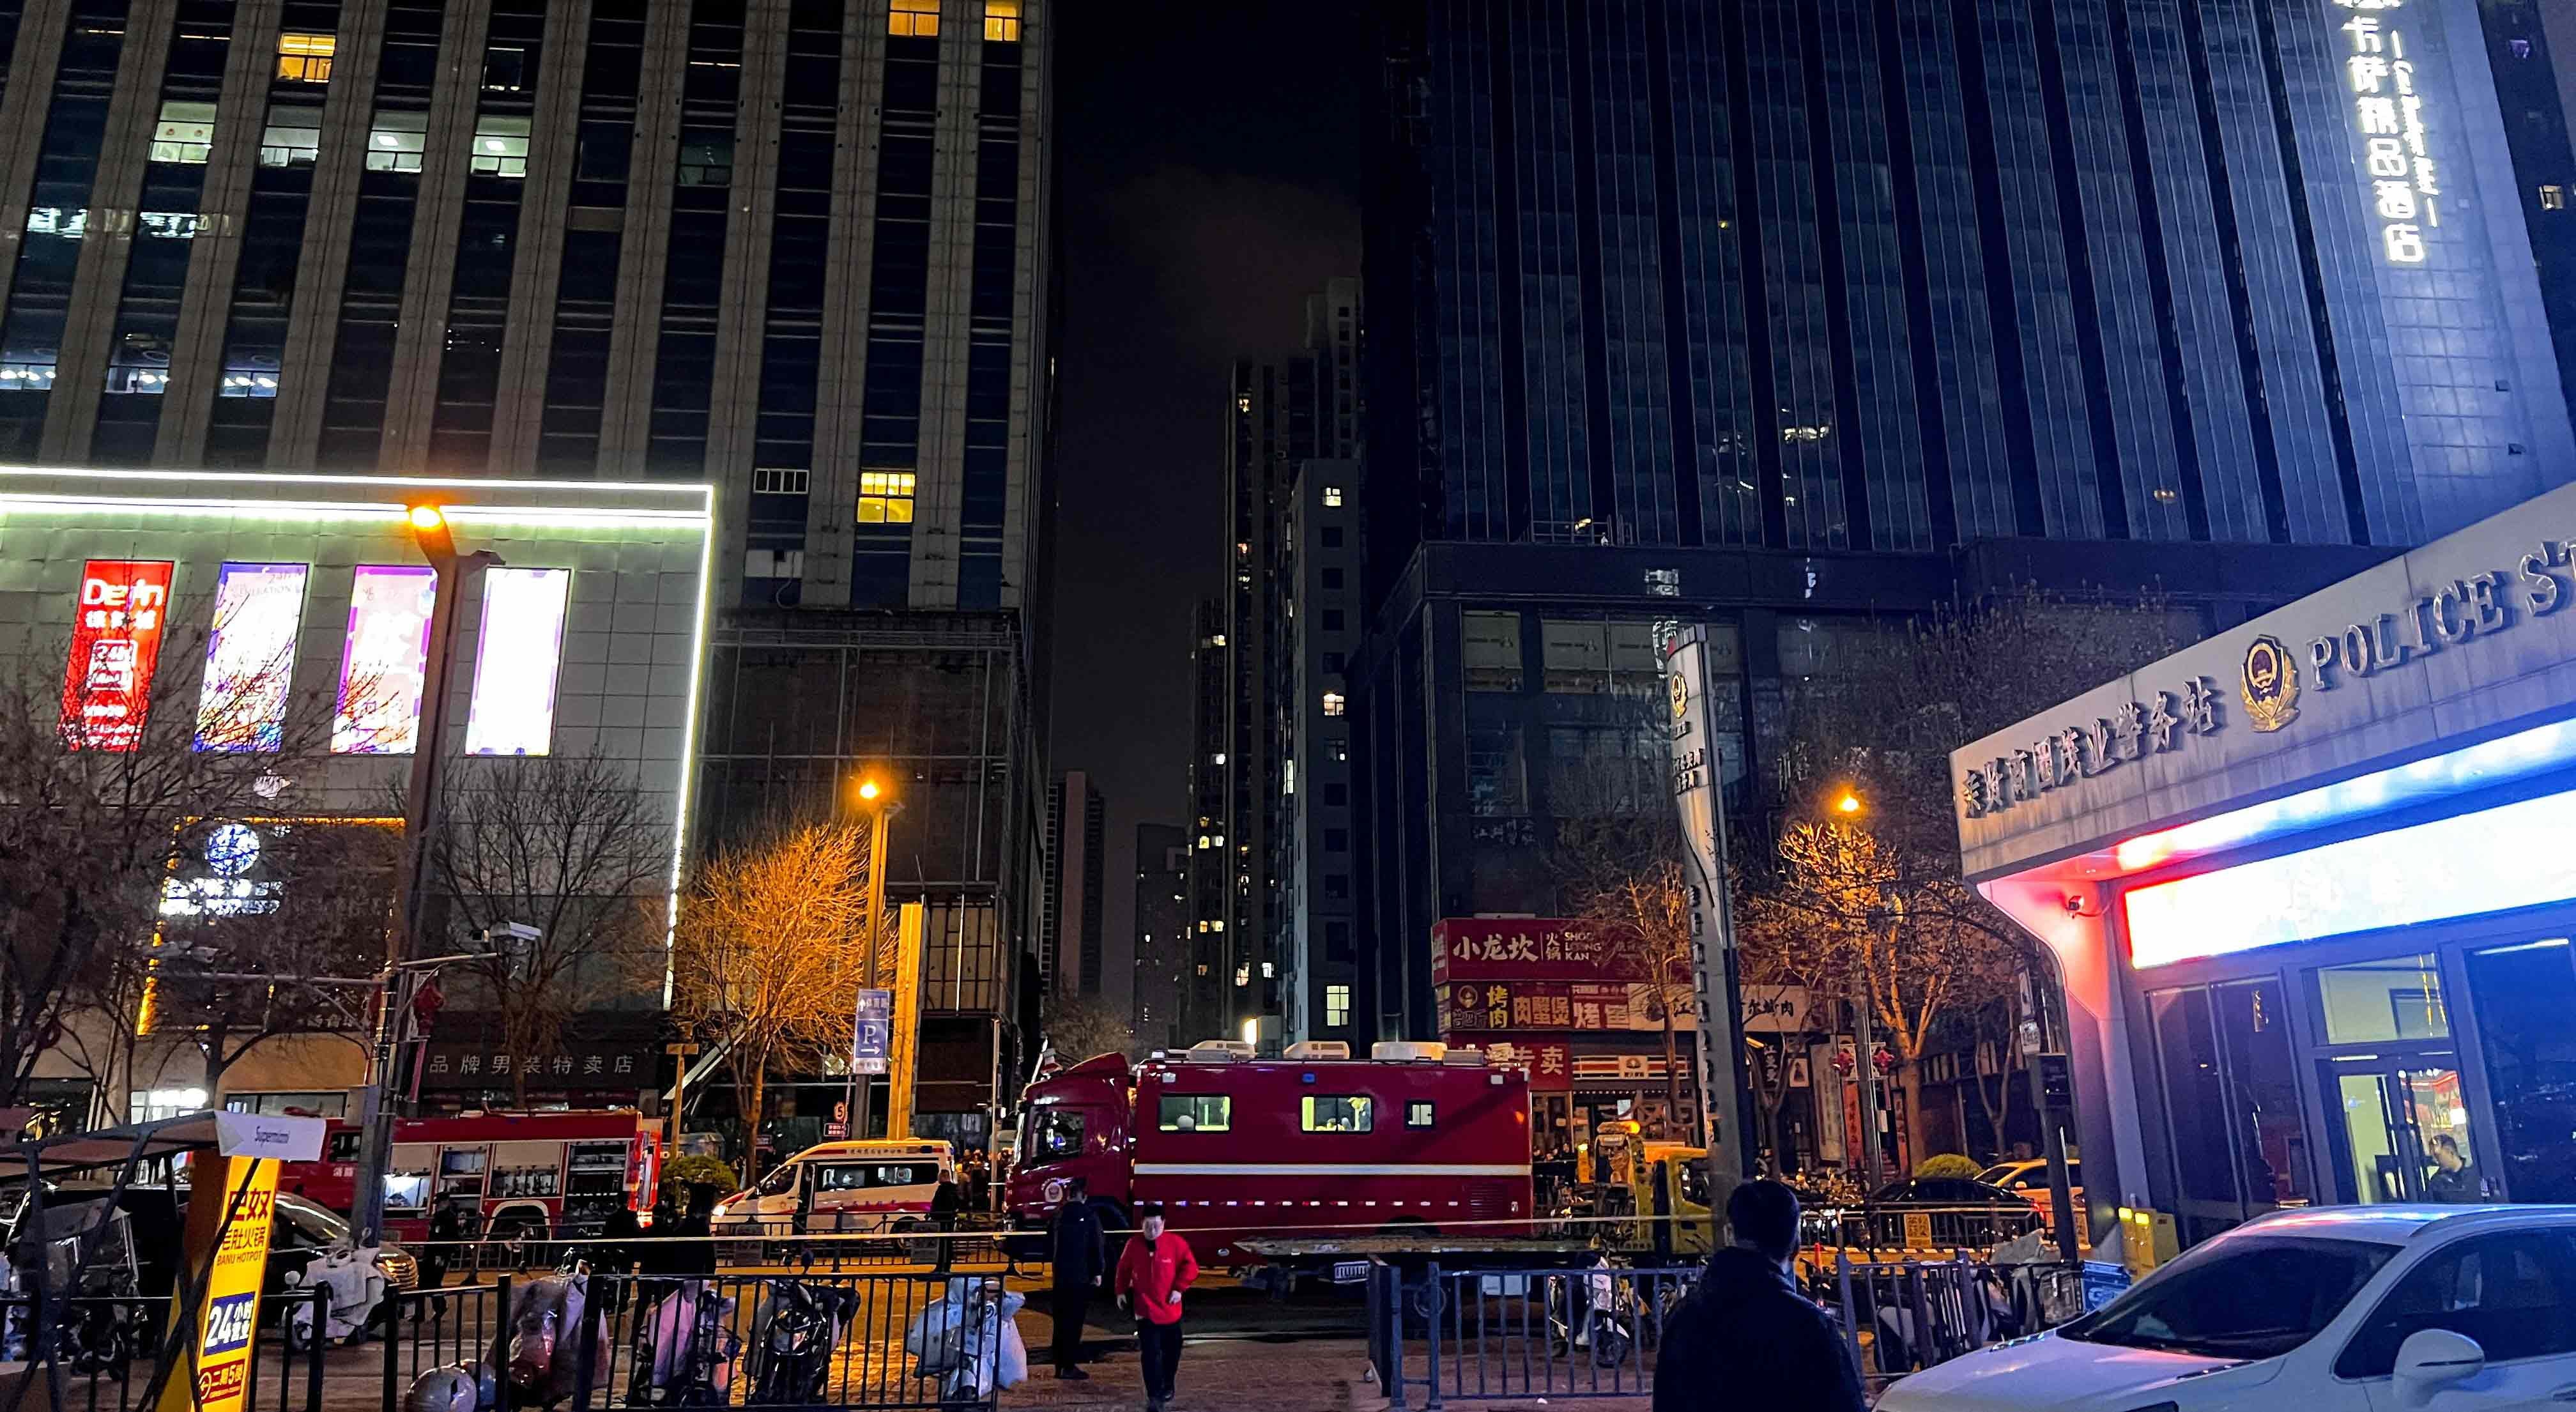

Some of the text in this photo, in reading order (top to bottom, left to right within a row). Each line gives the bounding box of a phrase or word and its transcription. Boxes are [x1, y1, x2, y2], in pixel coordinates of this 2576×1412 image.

[2306, 572, 2504, 691] POLICE
[1452, 933, 1539, 962] 小龙坎
[1546, 932, 1561, 961] 火锅
[1565, 952, 1590, 961] KAN
[1487, 985, 1508, 1029] 烤肉
[862, 1024, 877, 1045] P
[429, 1053, 635, 1075] 品牌男装特卖店
[217, 1250, 263, 1266] BANU HOTPOT
